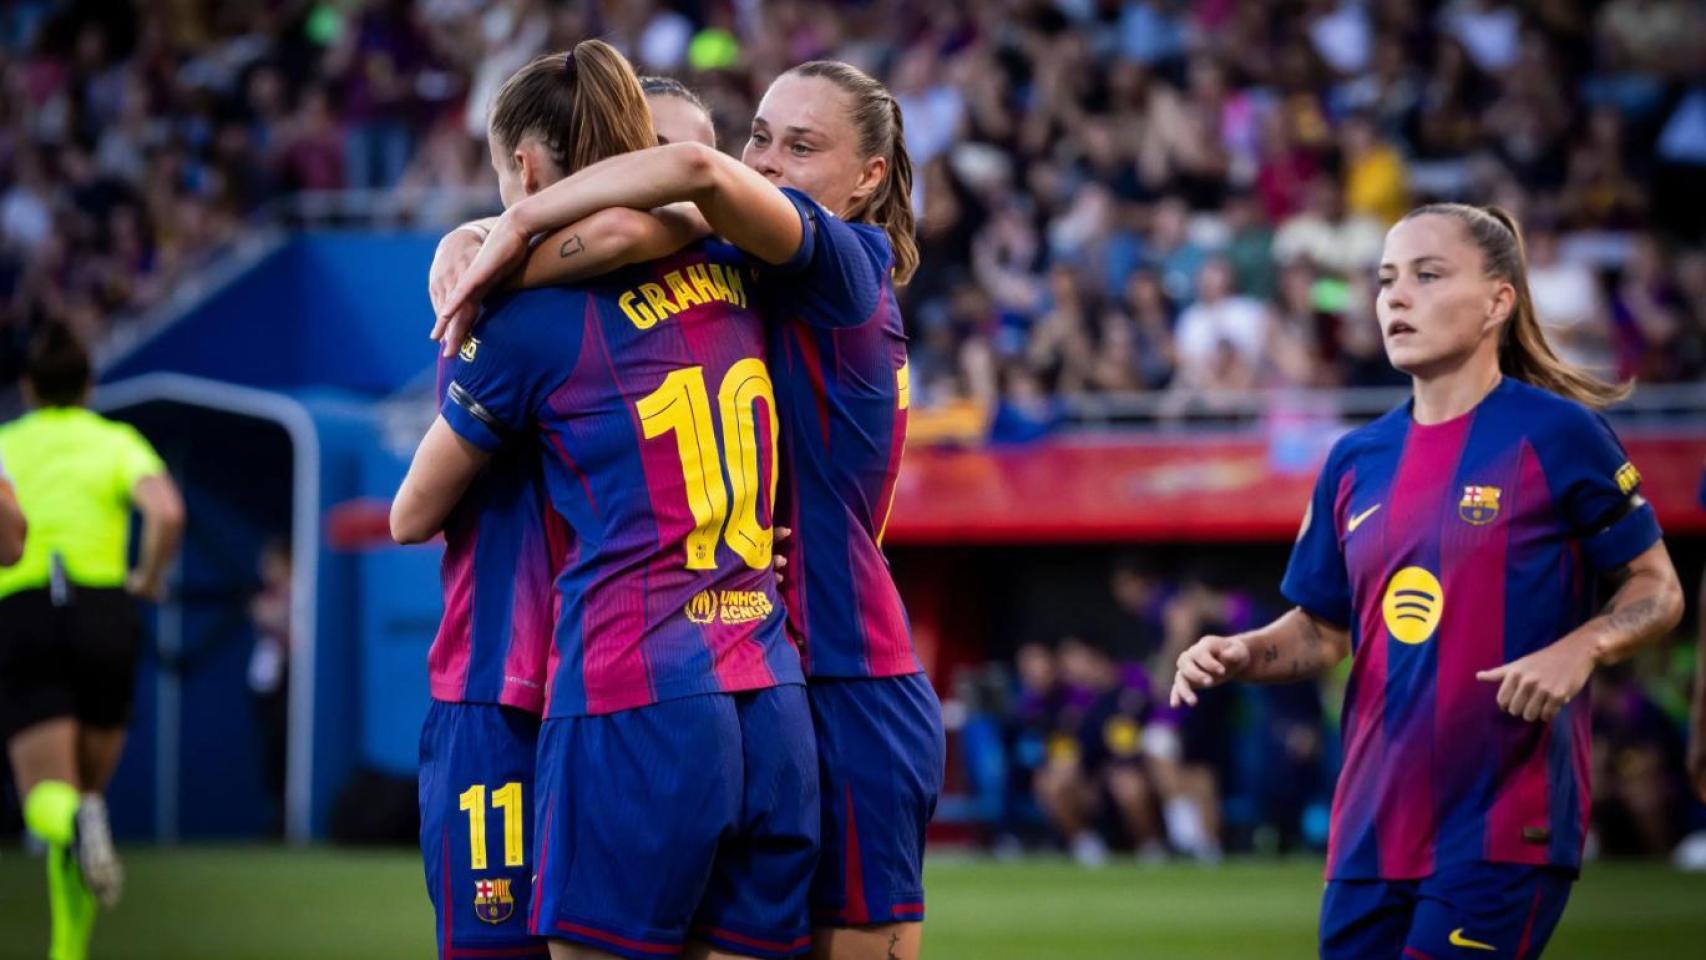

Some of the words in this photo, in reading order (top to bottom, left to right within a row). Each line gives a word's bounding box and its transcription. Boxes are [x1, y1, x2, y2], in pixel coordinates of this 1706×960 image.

[618, 263, 747, 330] GRAHAM
[635, 357, 779, 571] 10
[720, 590, 768, 607] UNHCR
[459, 782, 524, 870] 11
